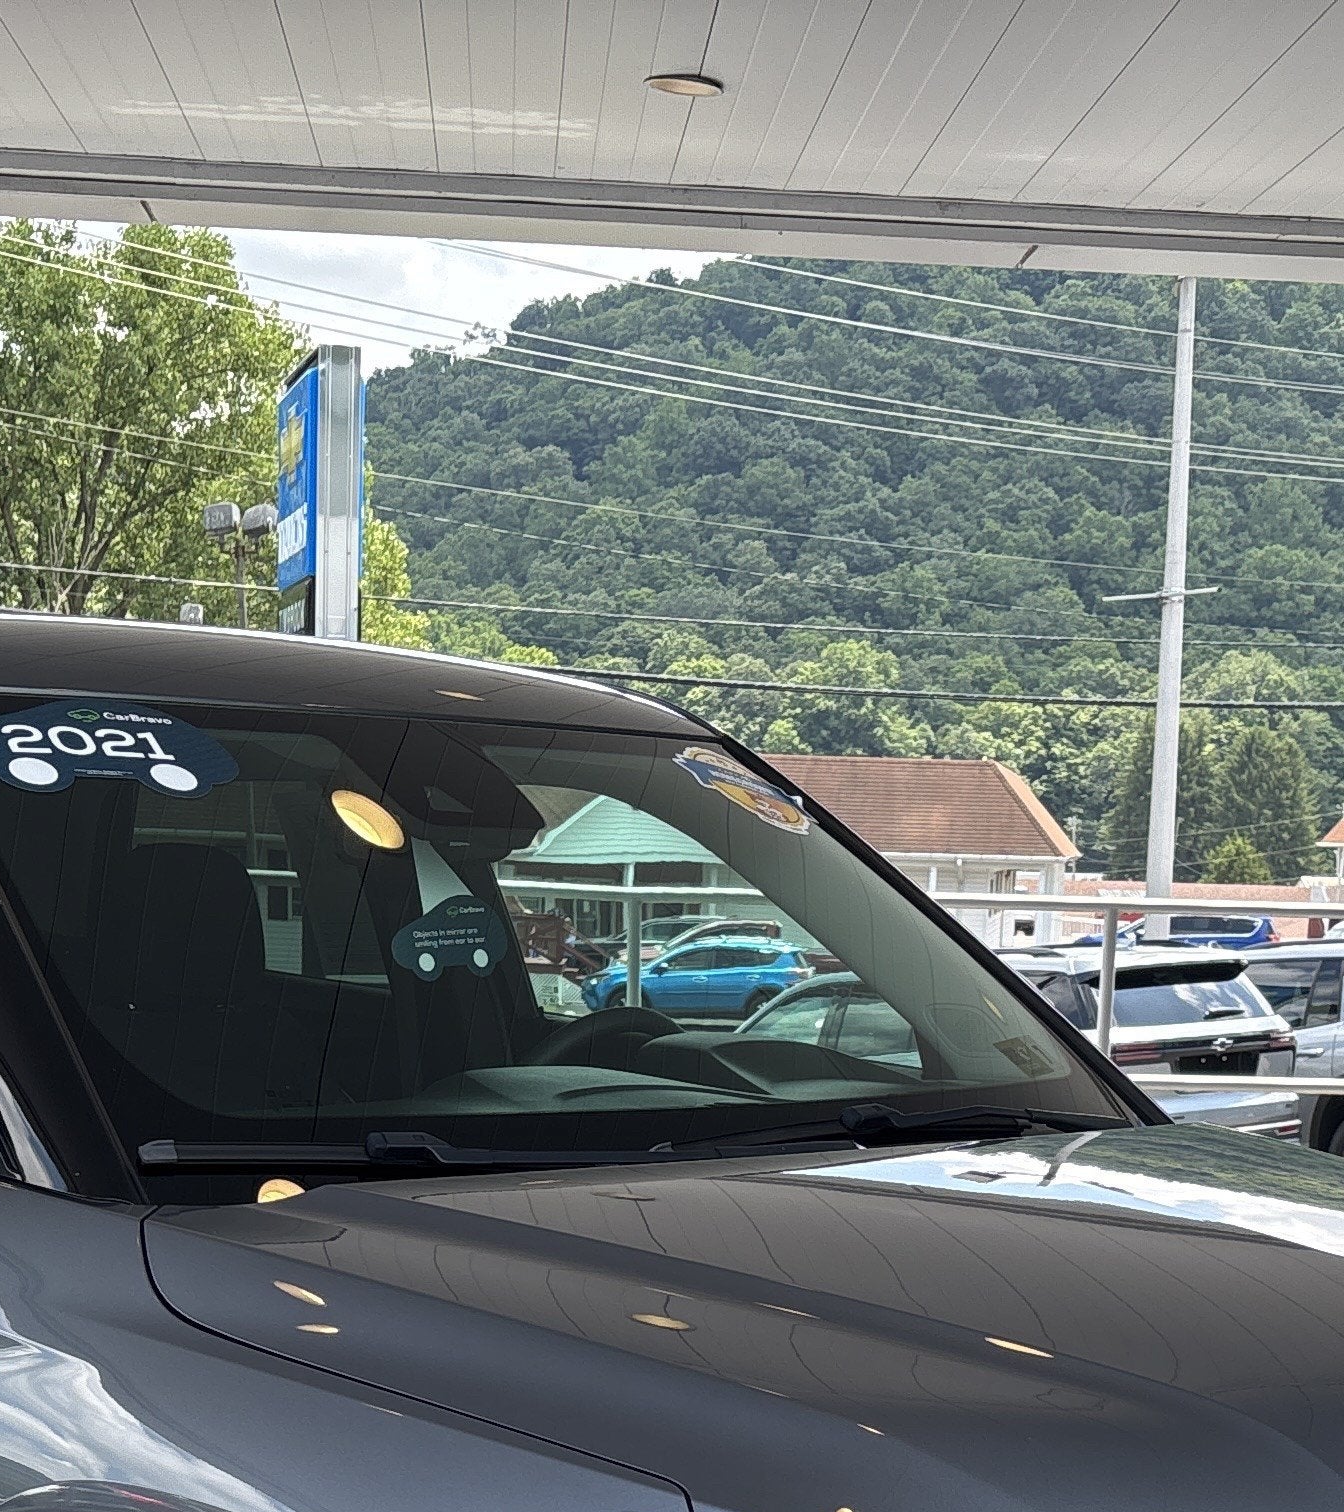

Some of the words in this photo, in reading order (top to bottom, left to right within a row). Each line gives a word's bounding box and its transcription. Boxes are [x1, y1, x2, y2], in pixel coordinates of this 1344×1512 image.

[102, 711, 173, 726] CarBravo
[0, 723, 176, 761] 2021
[413, 930, 439, 939] Objects
